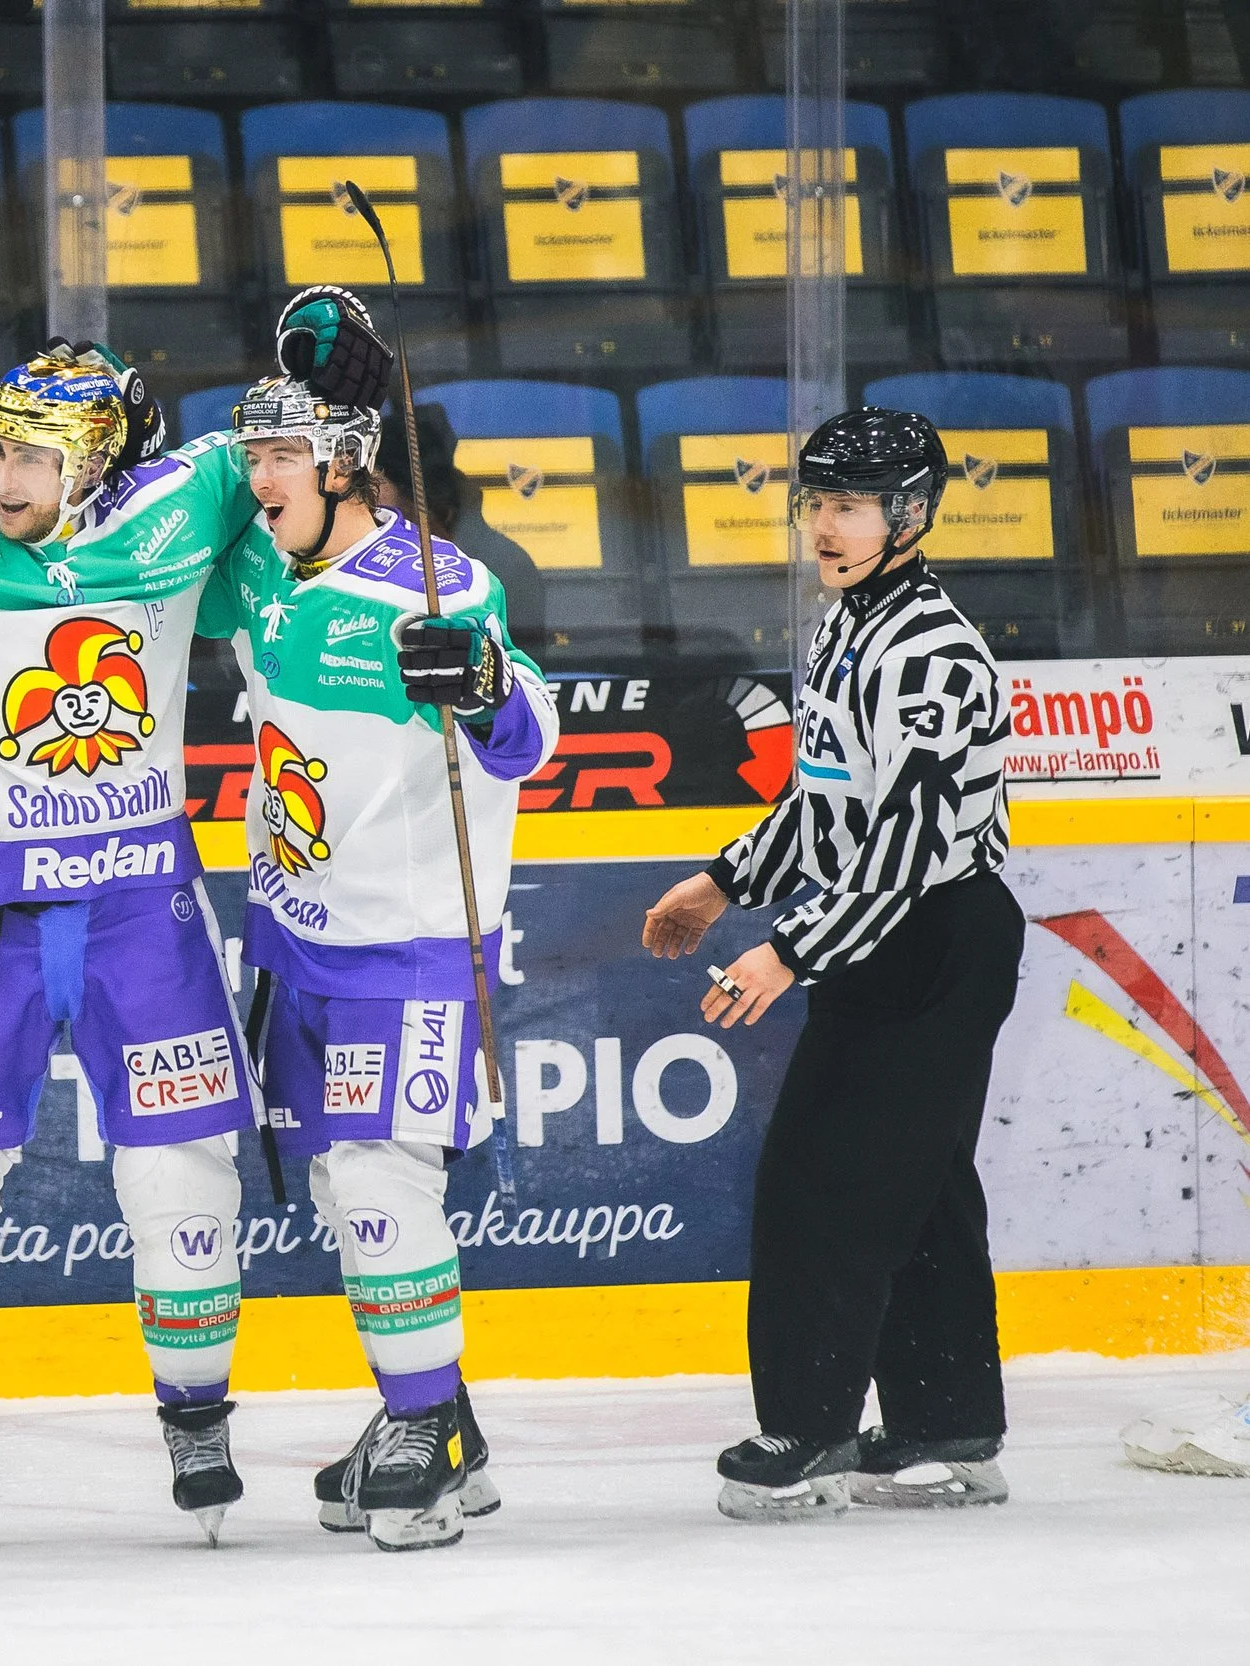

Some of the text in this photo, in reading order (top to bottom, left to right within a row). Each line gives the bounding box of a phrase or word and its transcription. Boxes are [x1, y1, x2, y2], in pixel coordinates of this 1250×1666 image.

[1193, 225, 1250, 238] ticketmas
[242, 402, 278, 410] CREATIVE
[941, 512, 1023, 524] ticketmaster
[1162, 508, 1243, 522] ticketmaster
[241, 543, 266, 571] Tervey
[317, 673, 386, 690] ALEXANDRIA
[1010, 676, 1153, 748] ämpö
[96, 766, 172, 821] Bank
[22, 837, 176, 891] Redan
[419, 1000, 448, 1061] HAL
[127, 1034, 231, 1076] CABLE
[326, 1050, 382, 1076] ABLE
[136, 1066, 229, 1108] CREW
[325, 1081, 374, 1107] REW
[361, 1269, 459, 1302] uroBrand
[157, 1292, 241, 1317] EuroBra
[379, 1296, 433, 1314] GROUP
[198, 1309, 238, 1327] GROUP
